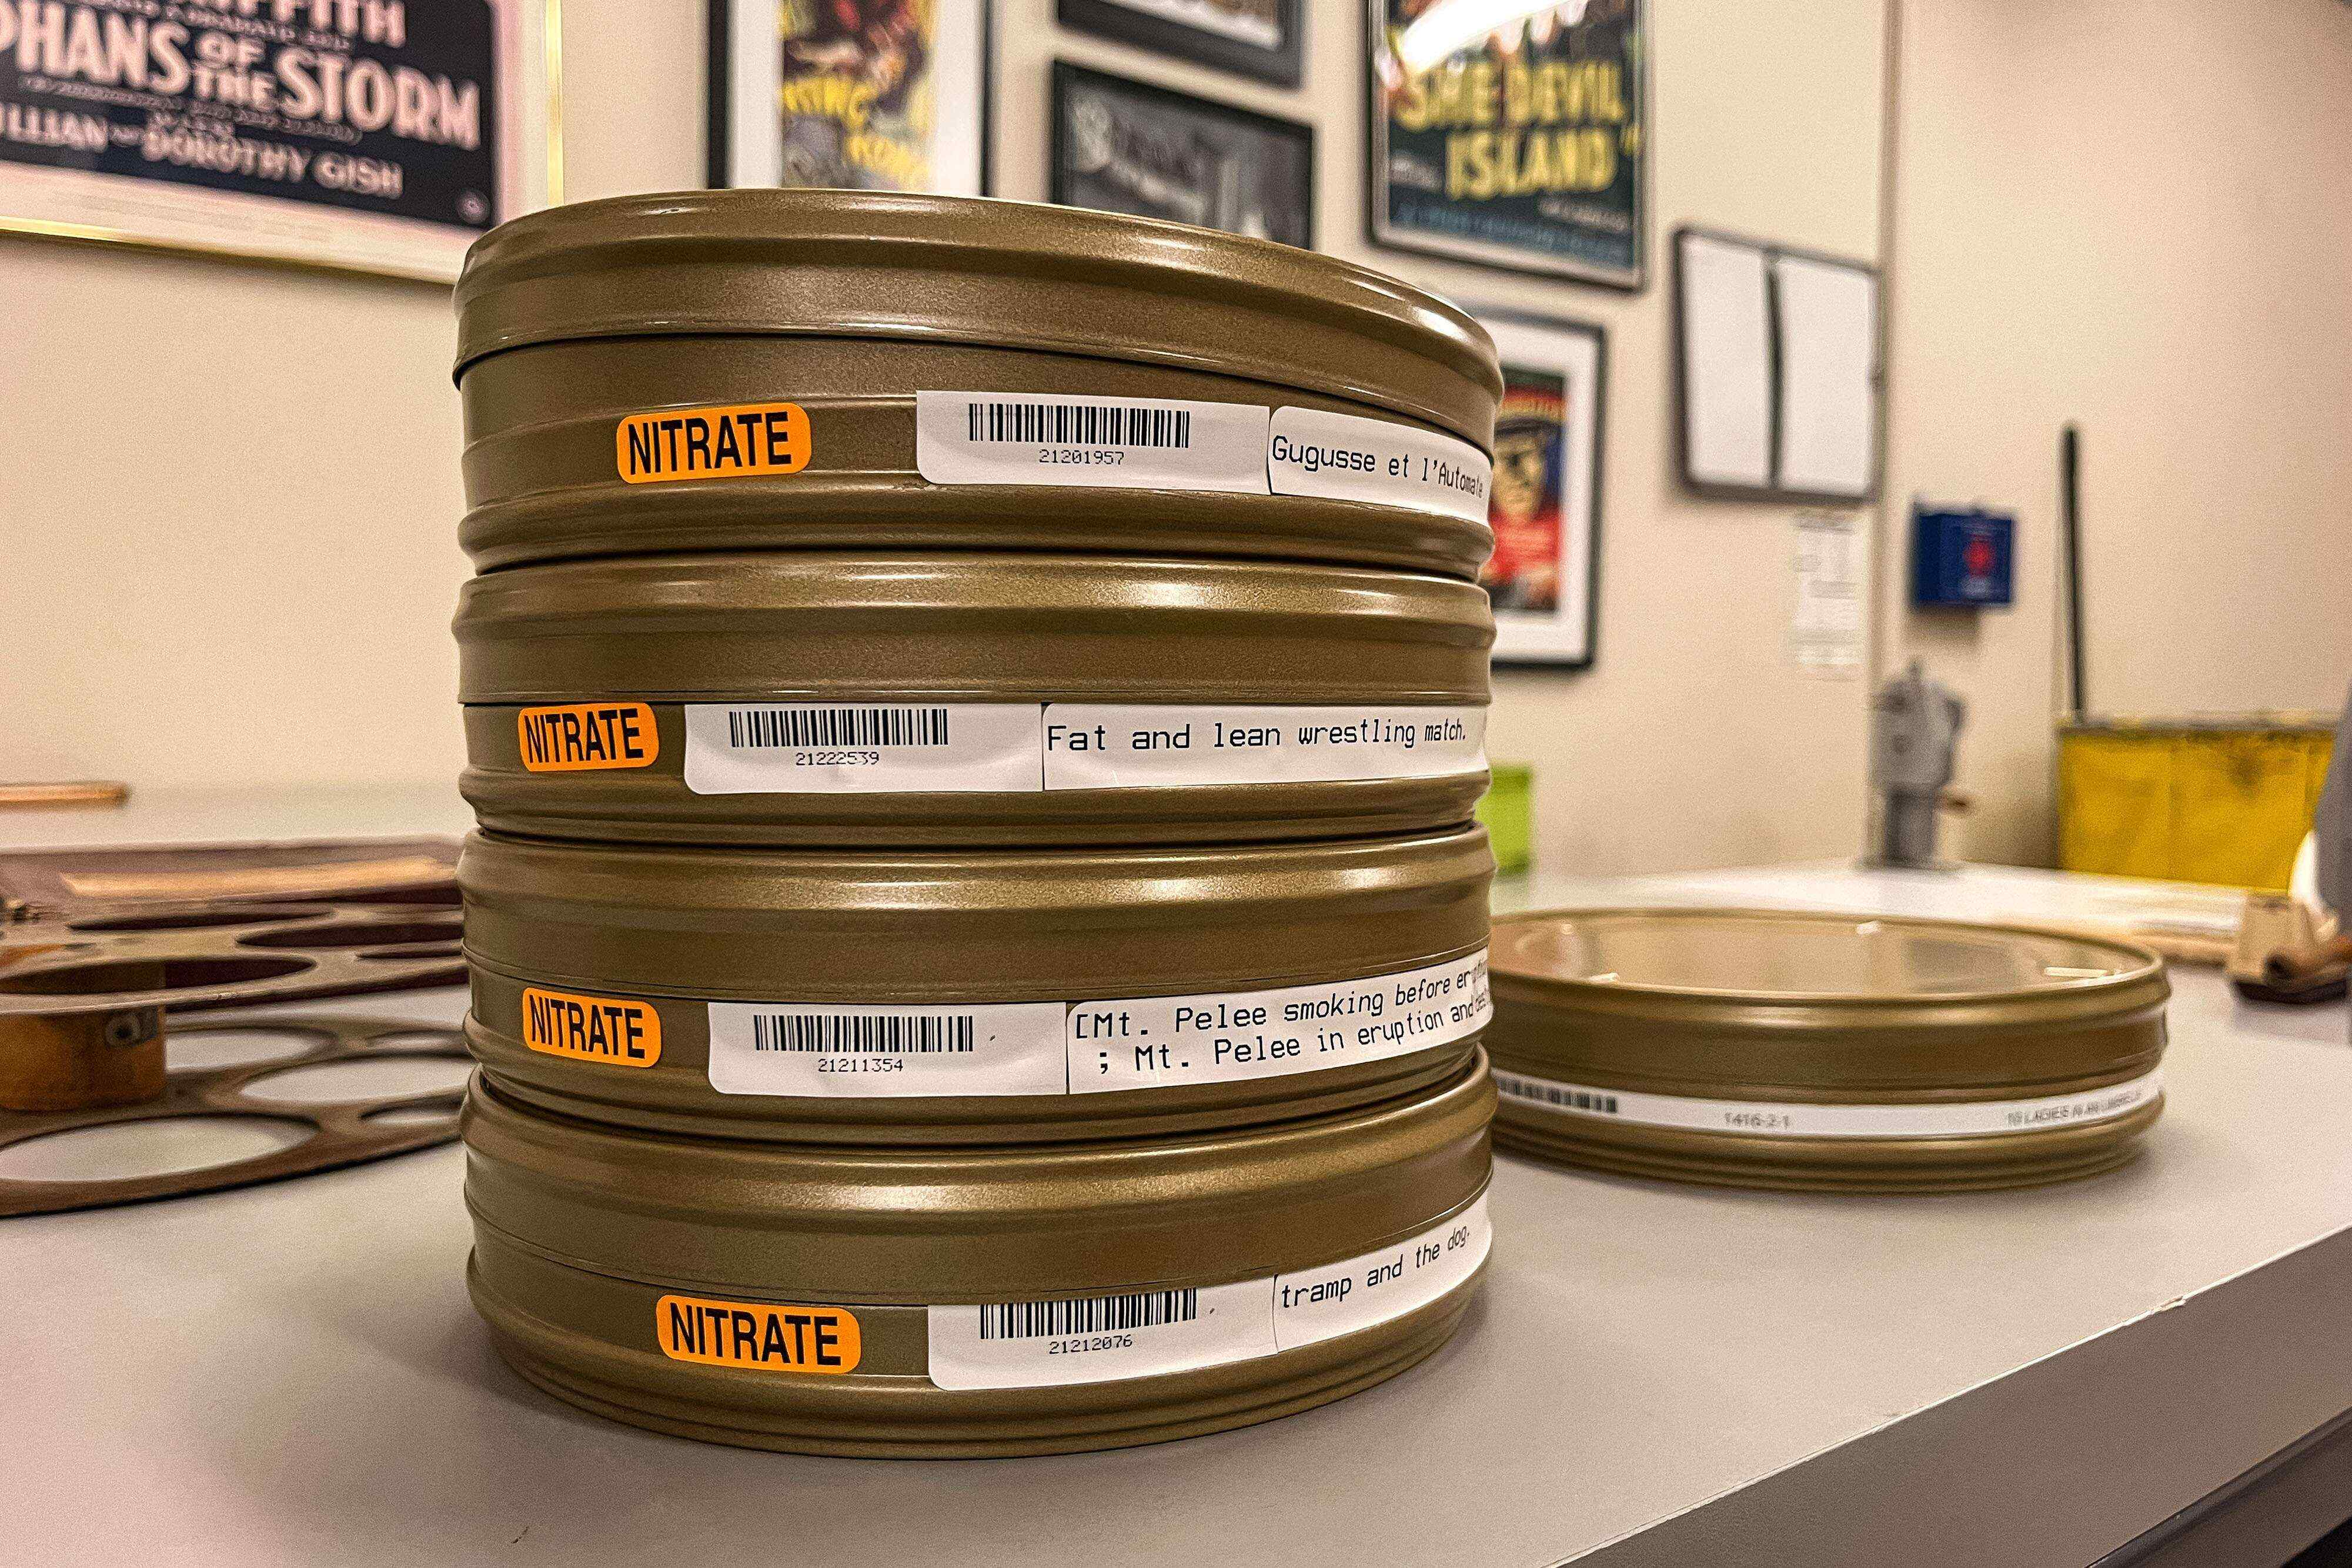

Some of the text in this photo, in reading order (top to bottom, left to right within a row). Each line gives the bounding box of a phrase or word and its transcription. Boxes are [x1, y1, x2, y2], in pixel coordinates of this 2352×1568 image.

[196, 31, 266, 69] OF
[193, 63, 276, 112] THE
[274, 46, 481, 151] STORM
[1505, 59, 1628, 125] DEVIL
[314, 152, 403, 199] GISH
[1445, 127, 1617, 200] ISLAND
[628, 412, 792, 475] NITRATE
[1039, 449, 1125, 466] 21201957
[1272, 435, 1483, 499] Gugusse et l'Automate
[524, 708, 644, 764] NITRATE
[796, 751, 880, 766] 21222539
[1047, 717, 1466, 751] Fat and lean wrestling match.
[529, 994, 646, 1059] NITRATE
[1076, 1011, 1149, 1039] [Mt.
[1175, 1004, 1267, 1032] Pelee
[1284, 991, 1384, 1022] smoking
[1395, 978, 1451, 1006] before
[818, 1058, 904, 1072] 21211354
[1135, 1044, 1190, 1071] Mt.
[1214, 1035, 1301, 1065] Pelee
[1317, 1027, 1344, 1052] in
[1358, 1010, 1444, 1045] eruption
[1281, 1225, 1470, 1308] tramp and the dog.
[670, 1302, 841, 1366] NITRATE
[1049, 1333, 1133, 1355] 21212076
